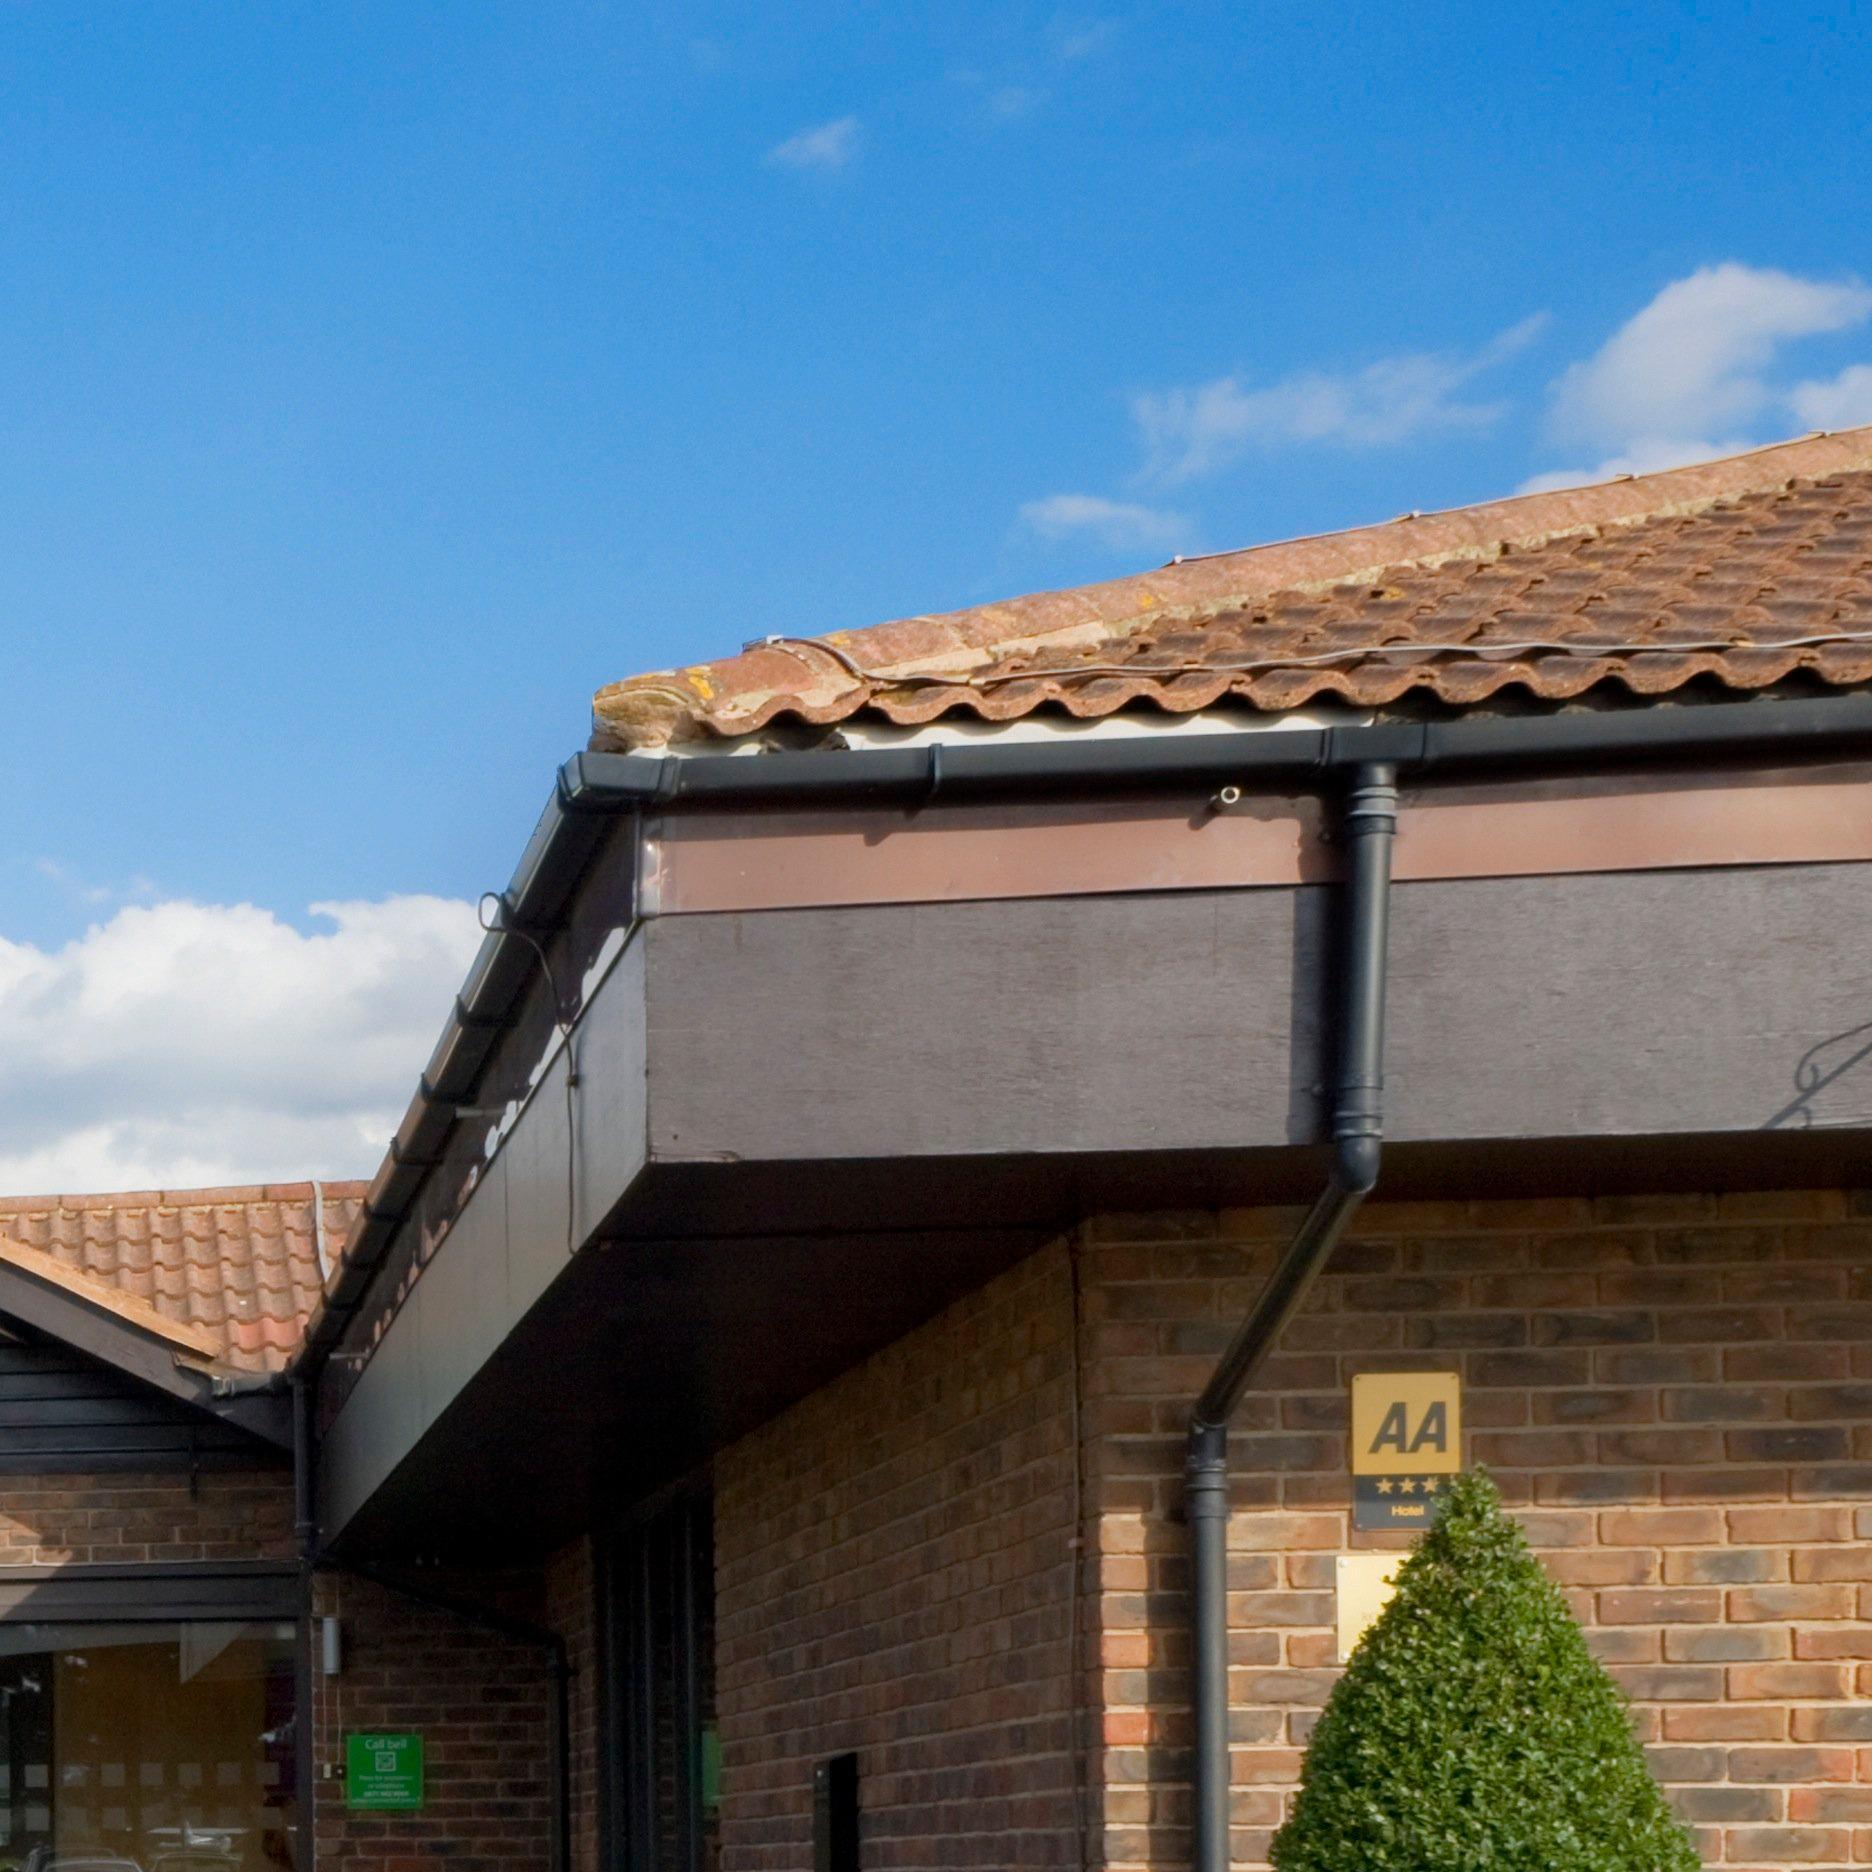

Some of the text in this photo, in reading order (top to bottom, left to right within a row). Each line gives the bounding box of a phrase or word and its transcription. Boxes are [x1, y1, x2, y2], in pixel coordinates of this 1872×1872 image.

[1368, 1401, 1447, 1454] AA
[1391, 1505, 1425, 1516] Hotel
[364, 1738, 408, 1750] Call bell
